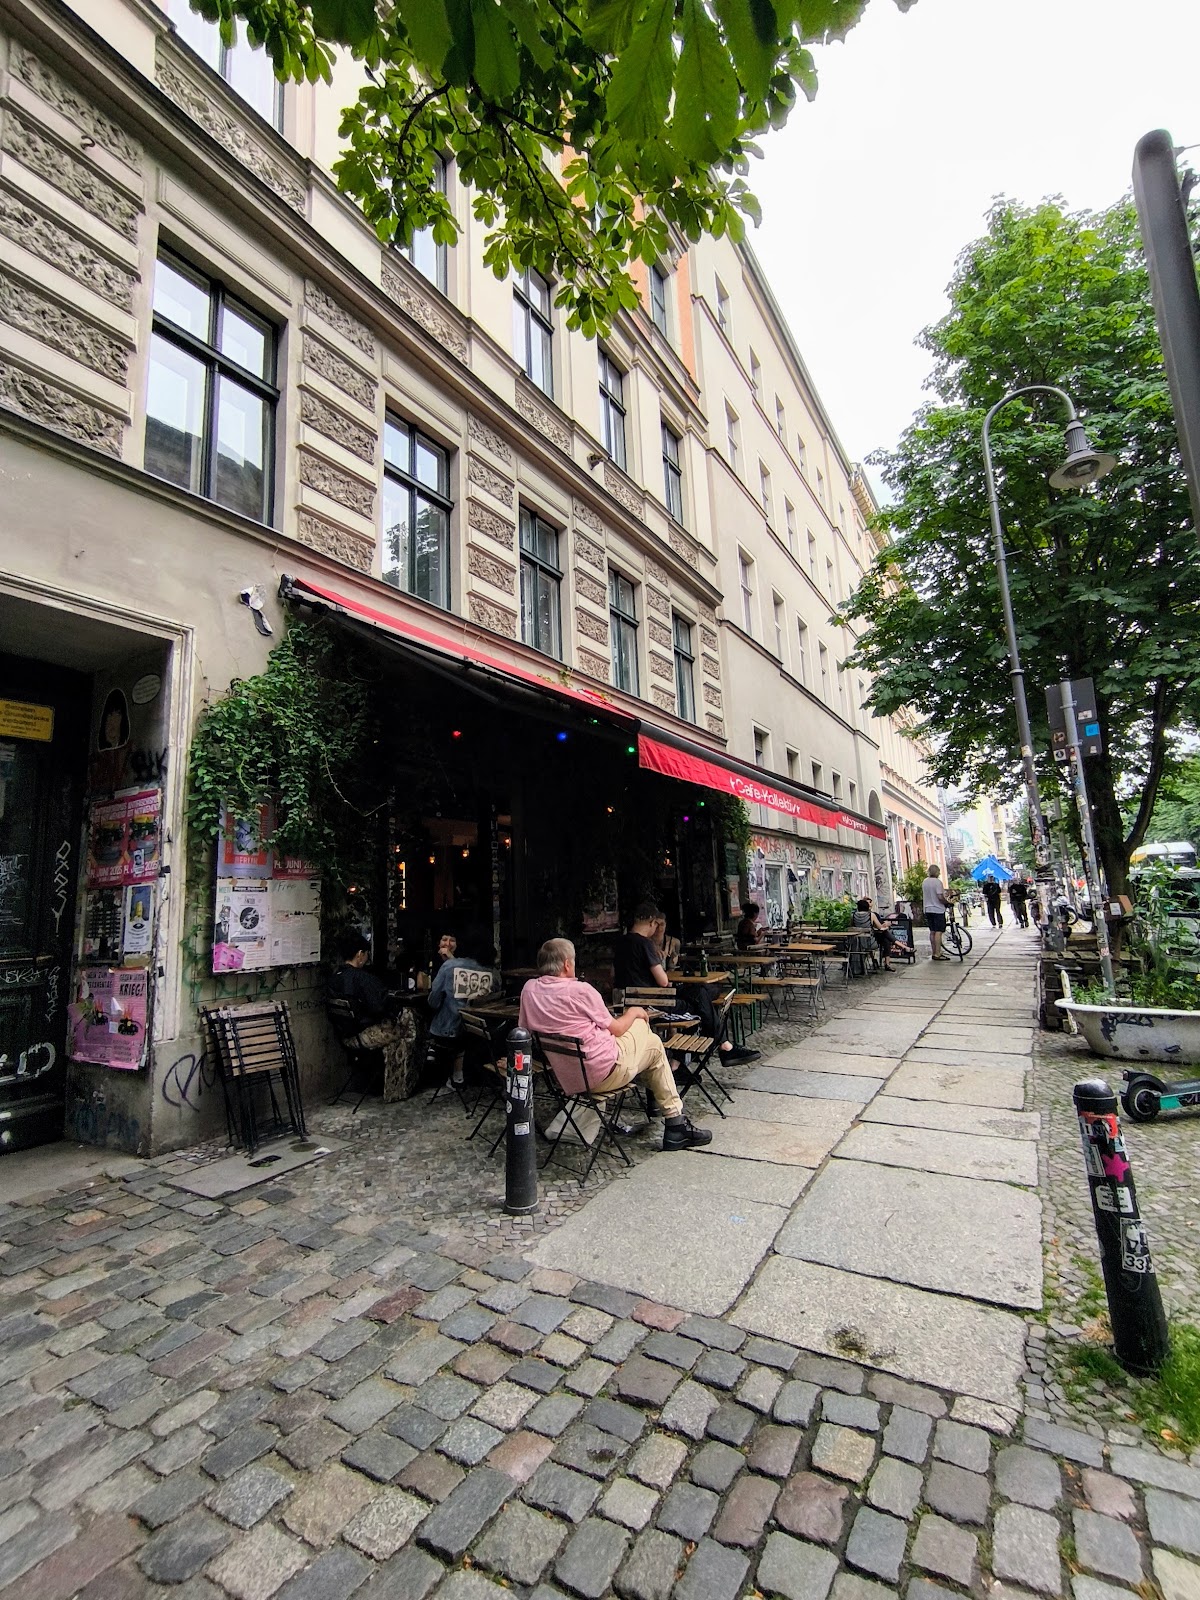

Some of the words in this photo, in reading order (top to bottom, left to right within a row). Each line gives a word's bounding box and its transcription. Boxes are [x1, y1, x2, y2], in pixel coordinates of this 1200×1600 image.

[286, 860, 302, 869] JUNI
[119, 983, 145, 997] KRIEG!
[1124, 1254, 1146, 1271] 33
